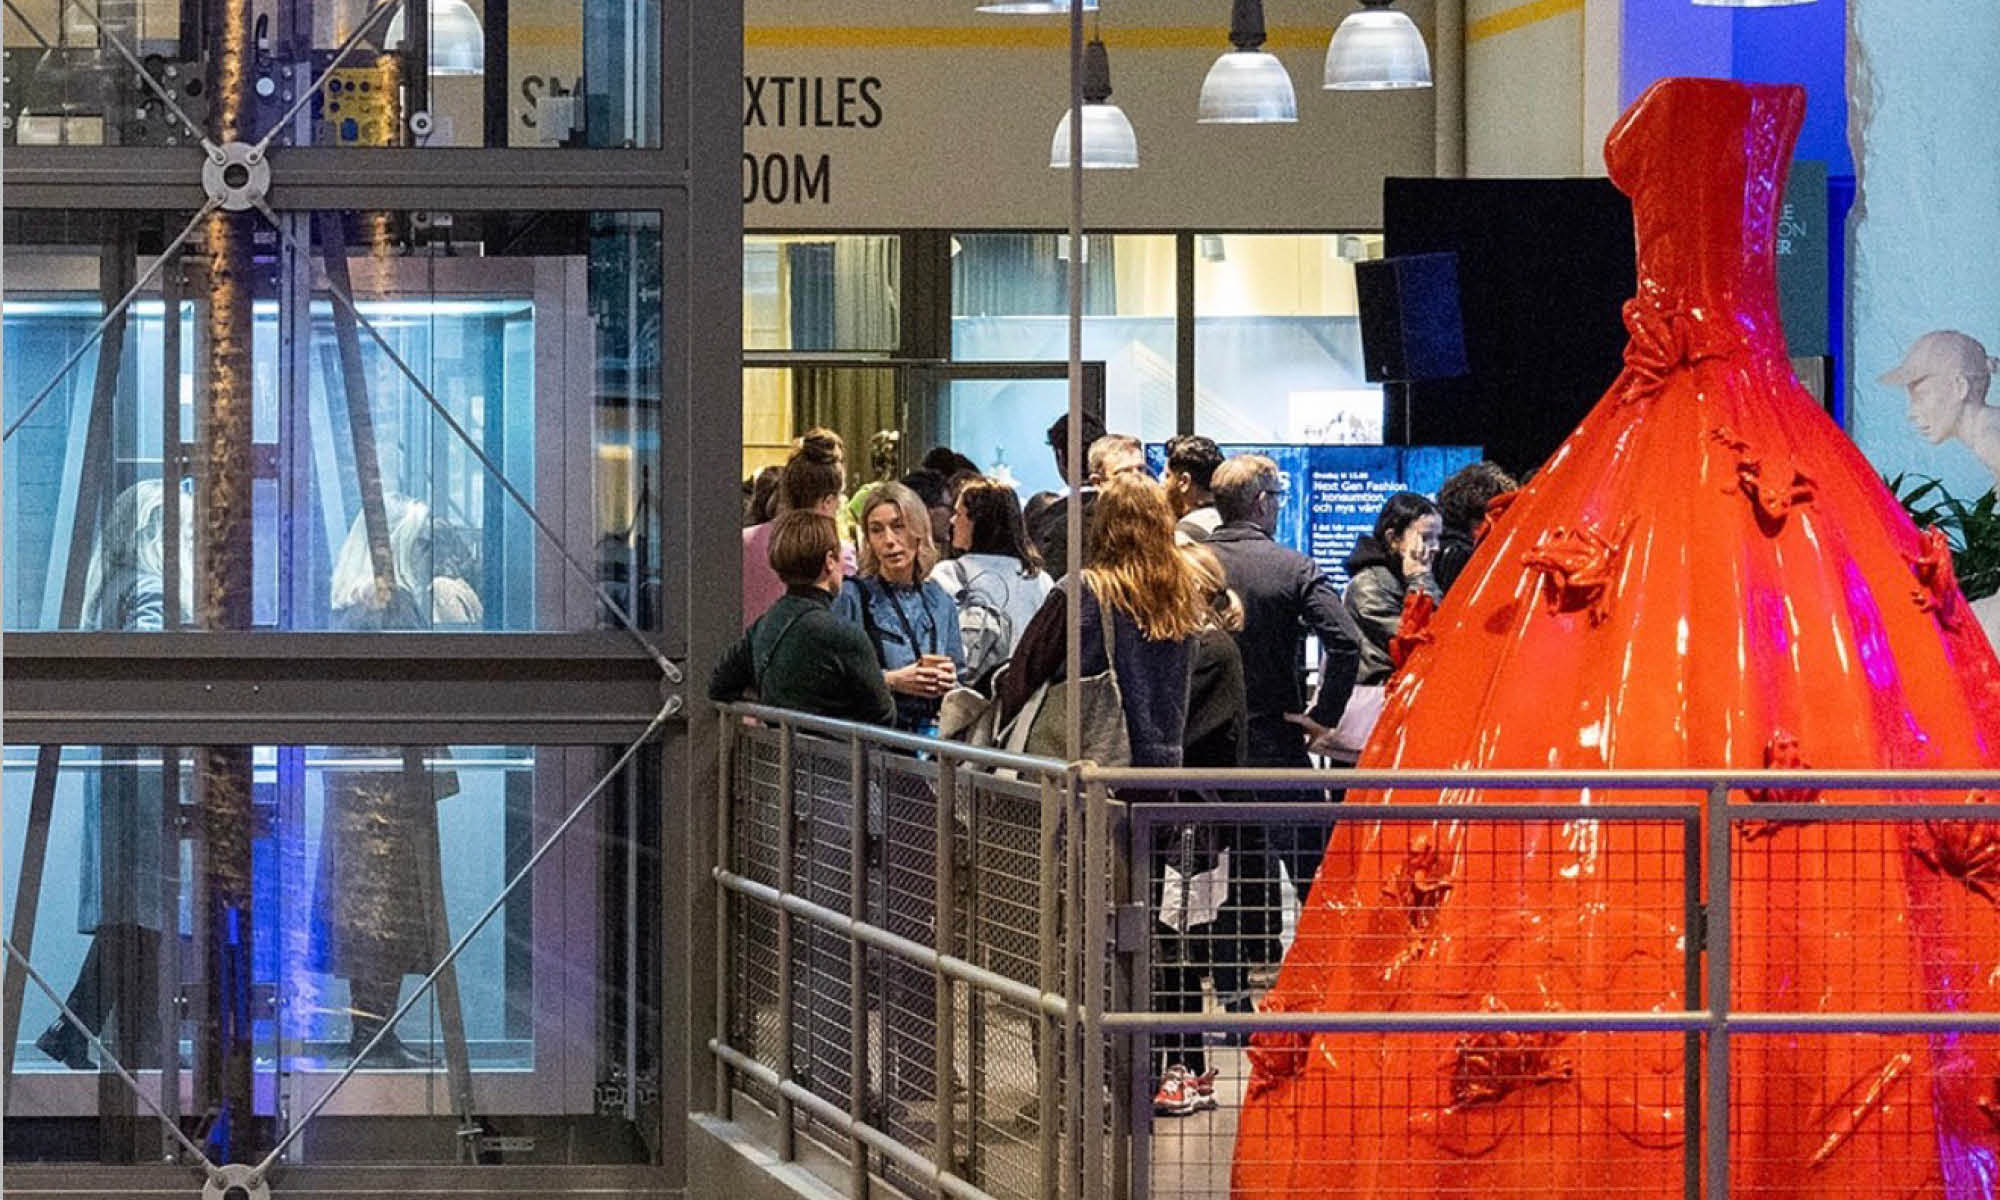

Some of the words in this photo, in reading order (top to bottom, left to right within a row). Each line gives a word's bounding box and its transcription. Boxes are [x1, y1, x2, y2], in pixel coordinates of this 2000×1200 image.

[743, 76, 883, 128] XTILES
[743, 153, 830, 204] OOM
[1777, 221, 1807, 237] ON
[1313, 481, 1339, 491] Next
[1341, 481, 1364, 491] Gen
[1366, 480, 1408, 491] Fashion
[1312, 503, 1333, 513] och
[1335, 504, 1356, 514] nya
